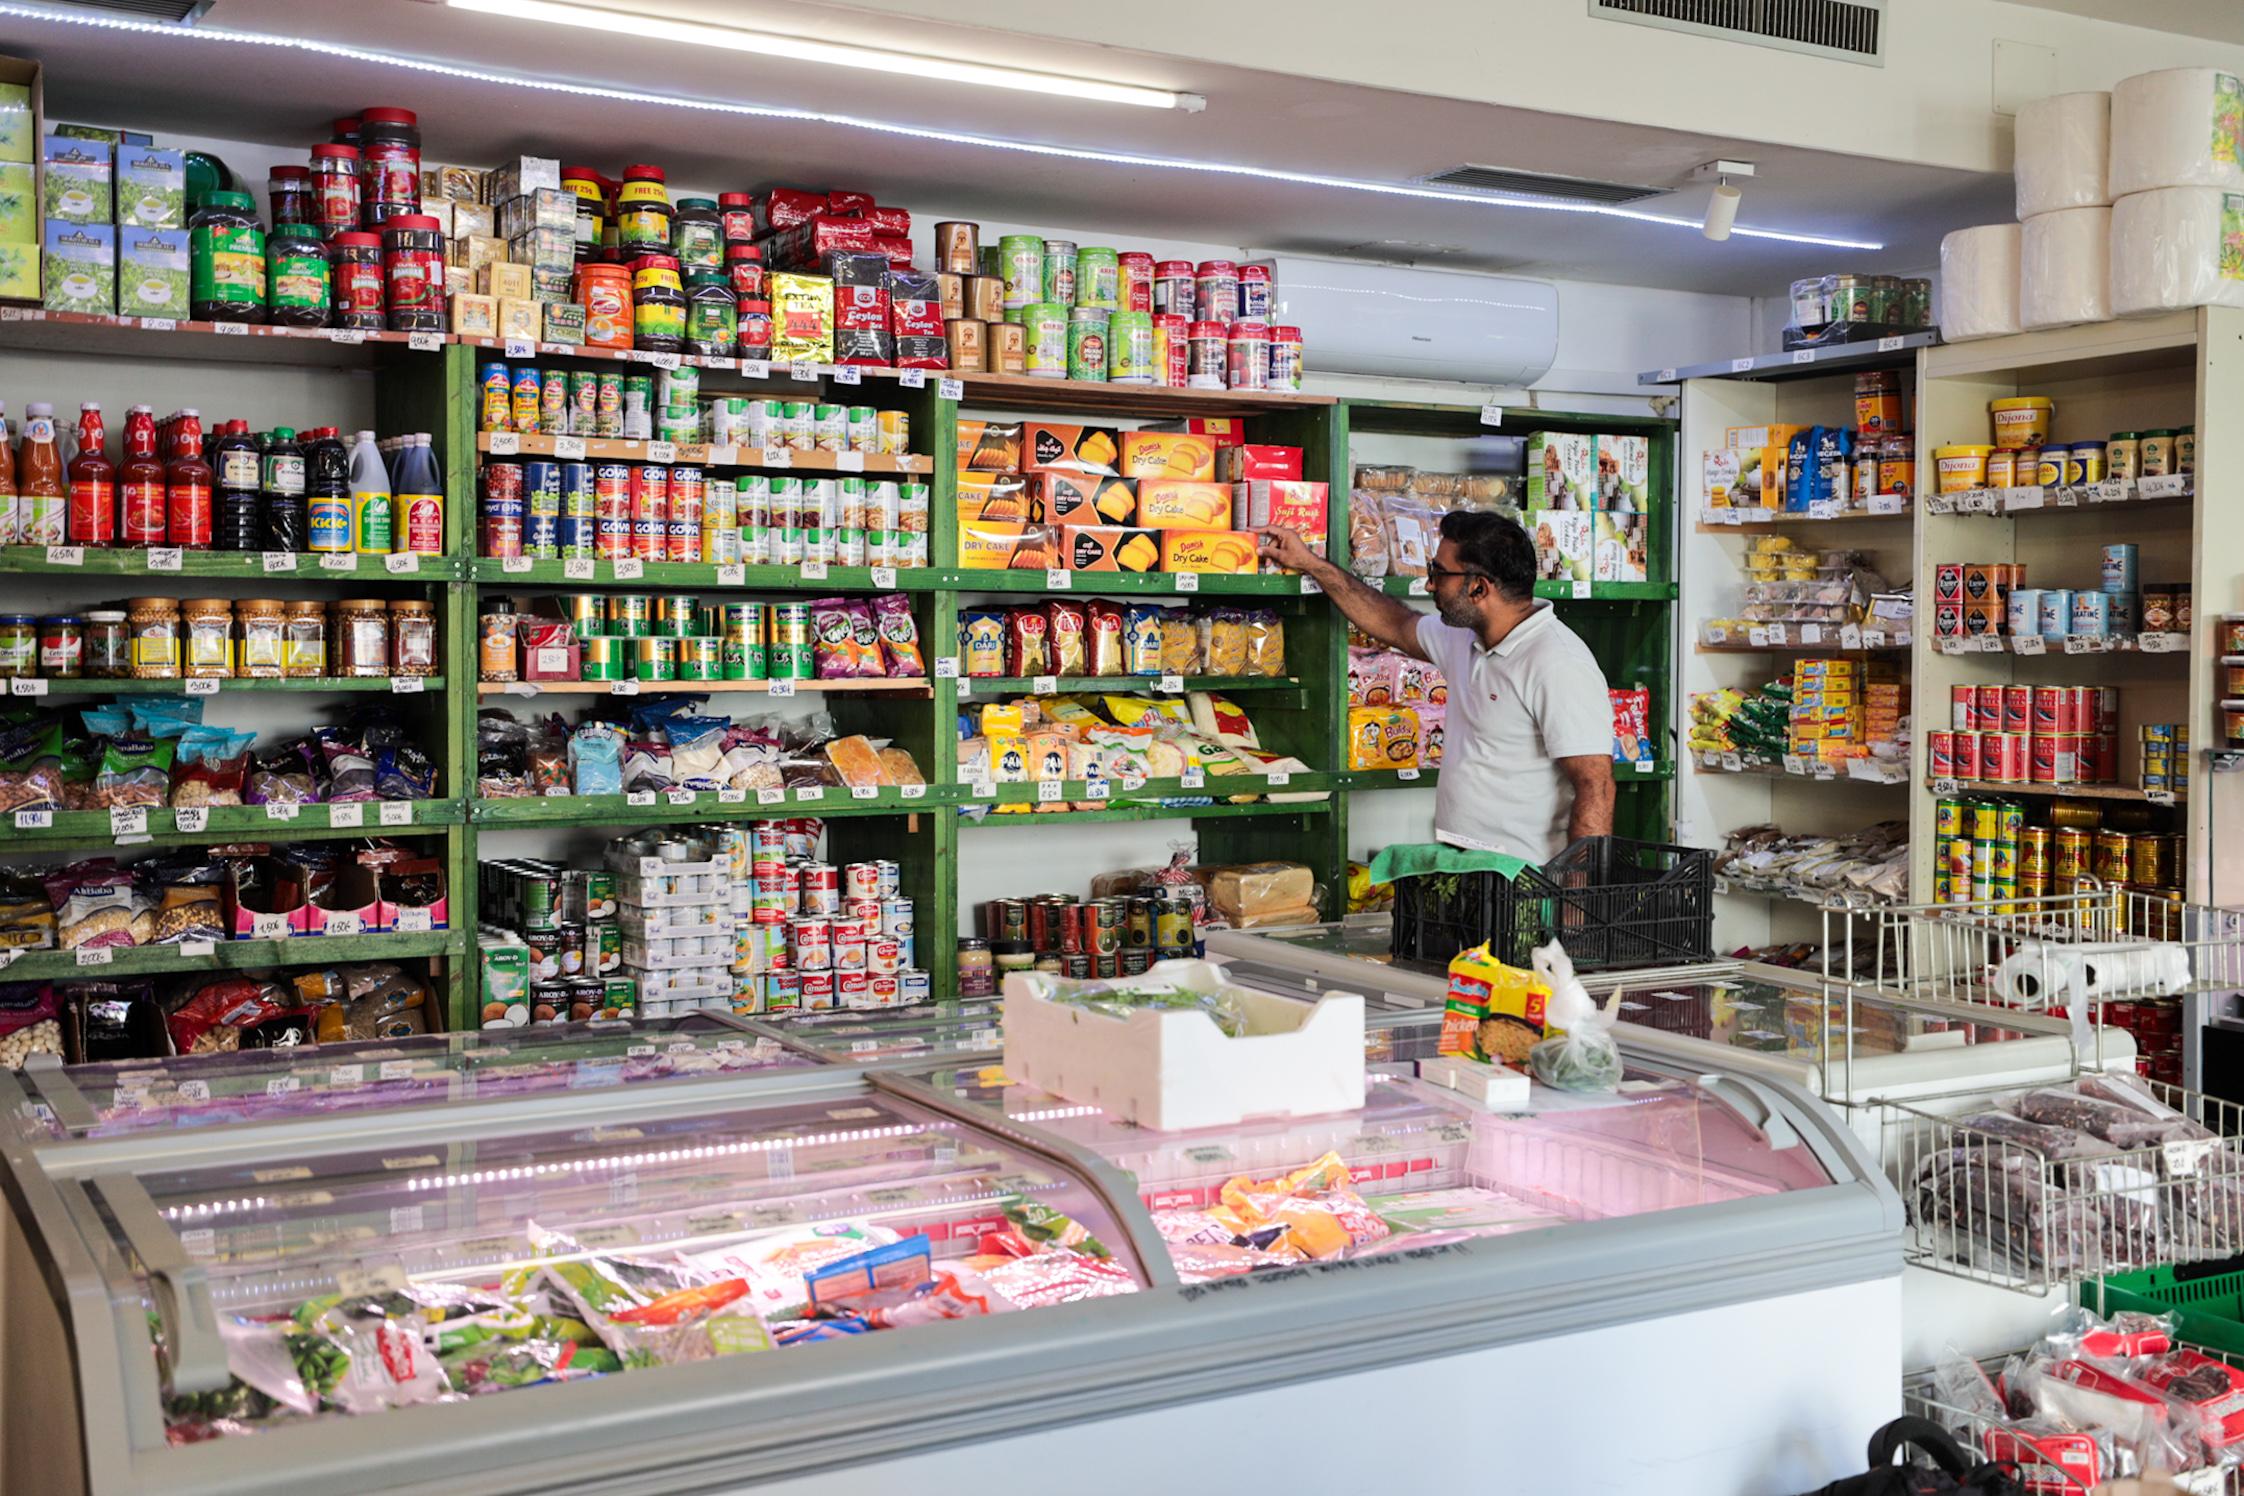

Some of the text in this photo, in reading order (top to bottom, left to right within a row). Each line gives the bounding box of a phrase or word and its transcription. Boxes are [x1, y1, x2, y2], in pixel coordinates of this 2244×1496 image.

[634, 187, 649, 195] FREE
[848, 311, 883, 322] Ceylon
[905, 319, 934, 330] Ceylon
[1997, 412, 2033, 427] Dijona
[1132, 456, 1167, 465] Dry Cake
[599, 467, 628, 479] GOYA
[1941, 461, 1976, 475] Dijona
[675, 468, 702, 480] GOYA
[959, 492, 982, 500] CAKE
[1165, 505, 1184, 513] Cake
[602, 520, 630, 533] GOYA
[635, 521, 665, 534] GOYA
[669, 522, 699, 534] GOYA
[965, 542, 1010, 551] DRY CAKE
[1173, 554, 1208, 563] Dry Cake
[975, 641, 997, 650] DARI
[1530, 999, 1541, 1012] 5
